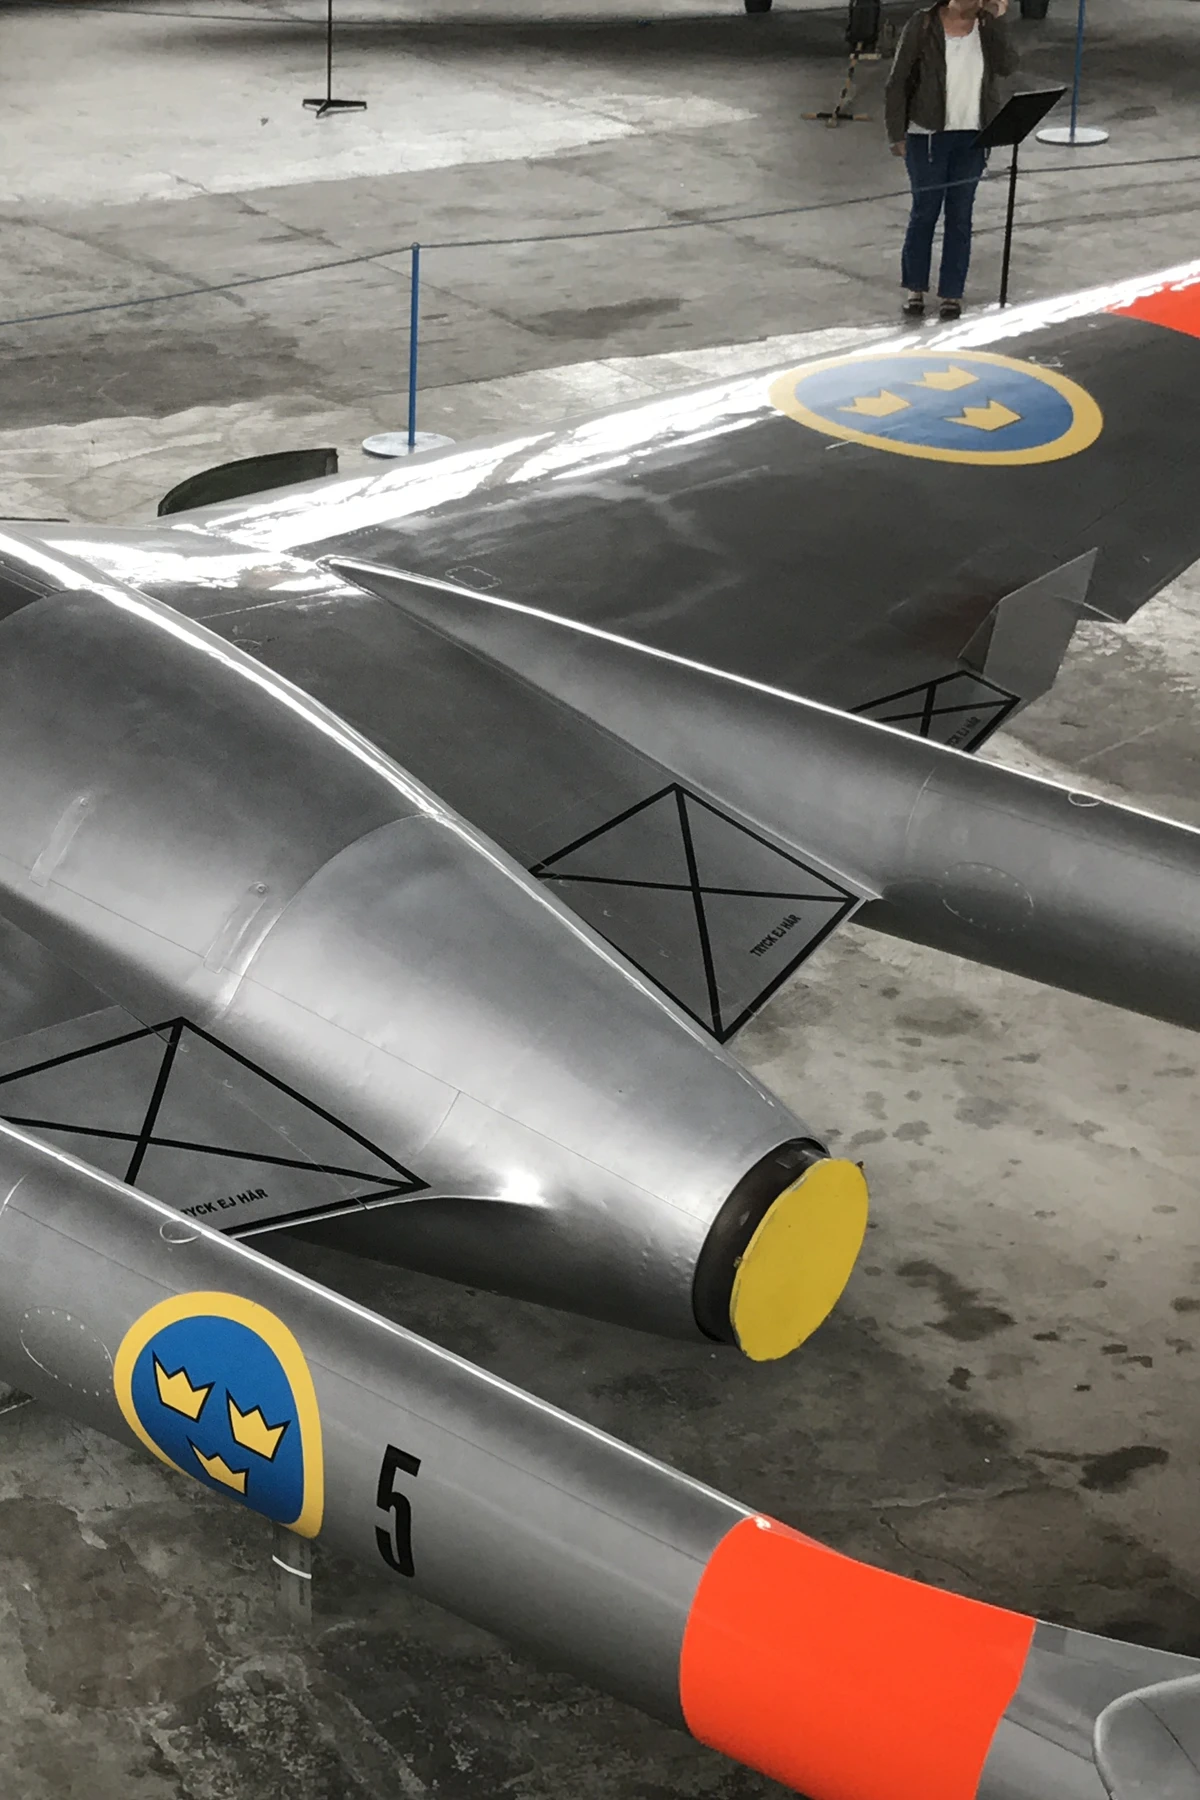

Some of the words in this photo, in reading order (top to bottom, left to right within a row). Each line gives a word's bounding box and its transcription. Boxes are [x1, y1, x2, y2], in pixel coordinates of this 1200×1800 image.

[750, 934, 778, 957] TRYCK
[772, 926, 786, 938] EJ
[217, 1196, 237, 1209] EJ
[236, 1188, 269, 1204] HÄR
[375, 1444, 421, 1577] 5
